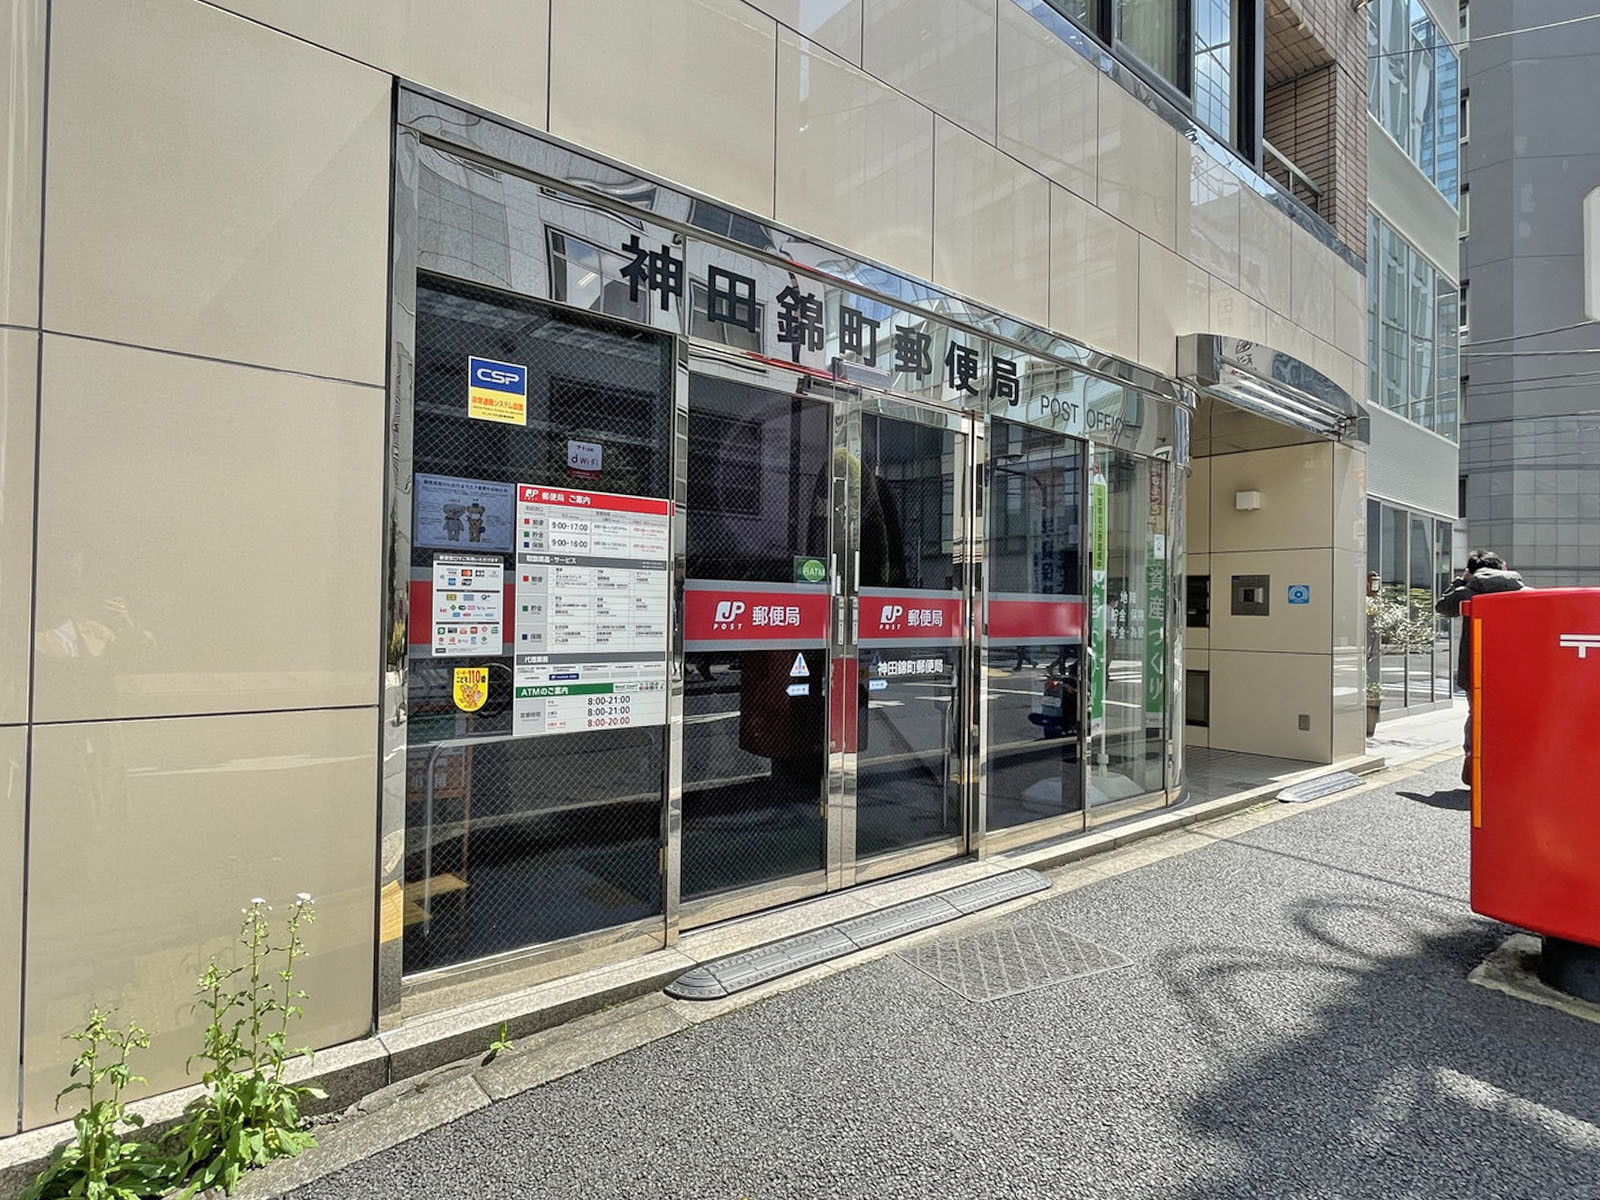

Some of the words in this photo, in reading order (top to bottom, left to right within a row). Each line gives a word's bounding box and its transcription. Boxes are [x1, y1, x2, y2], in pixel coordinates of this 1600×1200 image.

[619, 234, 1019, 407] 神田錦町郵便局
[476, 367, 520, 385] CSP
[1040, 394, 1079, 424] POST
[541, 491, 565, 502] 郵便局
[568, 495, 591, 505] ご案内
[752, 605, 801, 627] 郵便局
[907, 608, 943, 627] 郵便局
[877, 659, 944, 676] 神田錦町郵便局
[521, 686, 569, 697] ATMのご案内
[587, 695, 631, 706] 8:00-21:00
[587, 706, 631, 717] 8:00-21:00
[587, 716, 631, 728] 8:00-20:00
